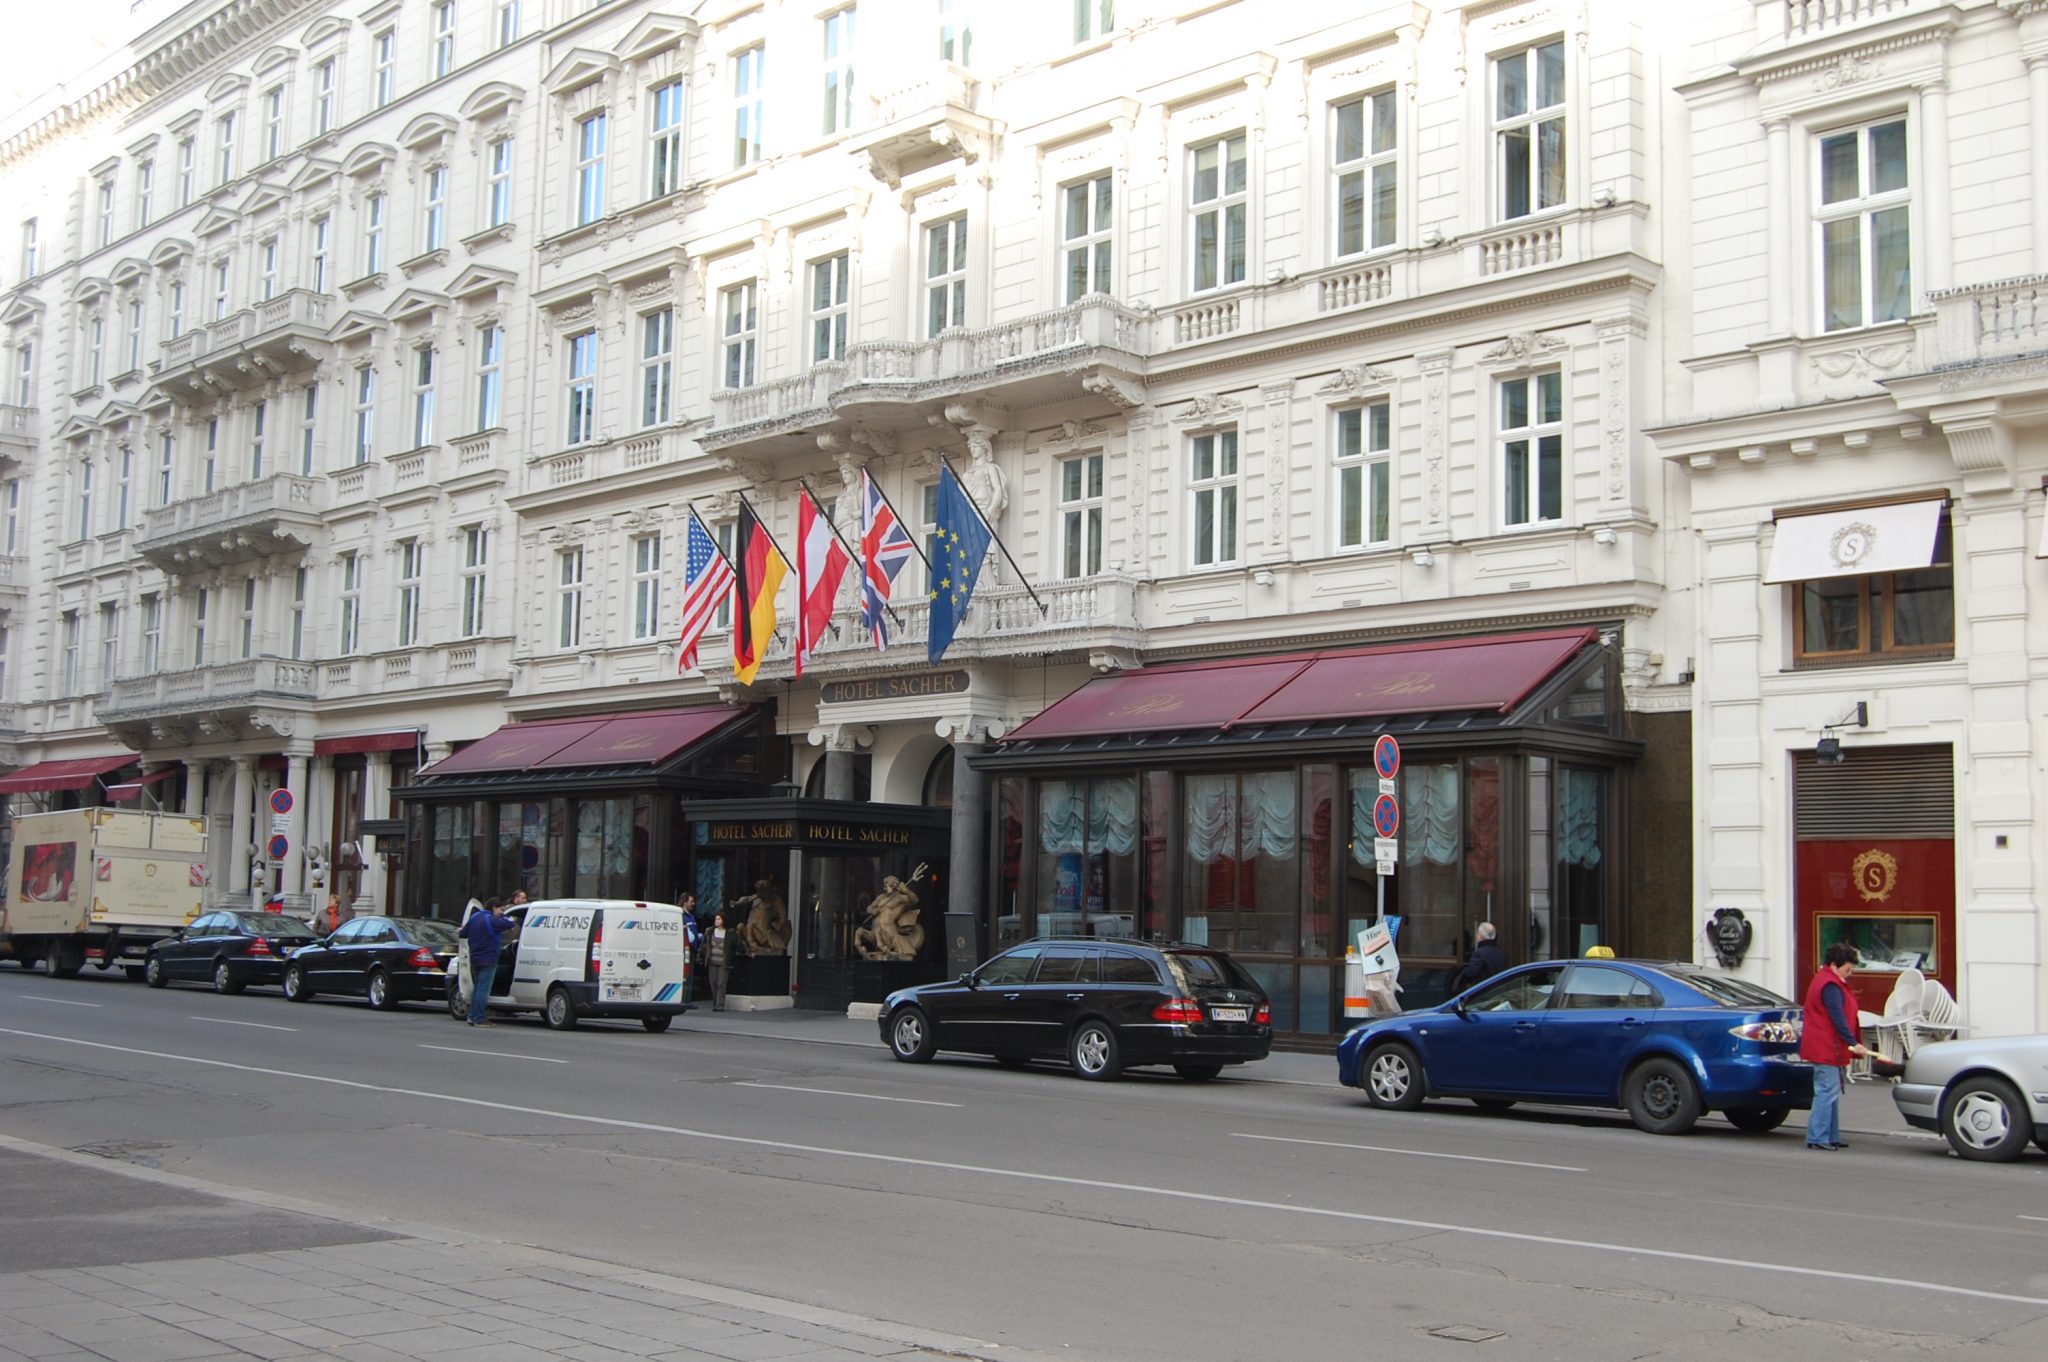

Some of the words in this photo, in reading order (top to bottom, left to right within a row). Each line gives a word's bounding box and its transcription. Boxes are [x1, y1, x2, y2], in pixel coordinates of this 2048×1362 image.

[1845, 538, 1858, 556] S
[834, 682, 884, 701] HOTEL
[889, 674, 956, 696] SACHER
[713, 825, 747, 840] HOTEL
[751, 823, 793, 838] SACHER
[809, 824, 853, 841] HOTEL
[859, 828, 909, 844] SACHER
[1868, 867, 1881, 888] S
[539, 915, 590, 930] ALLTRANS
[633, 921, 679, 931] ALLTRANS
